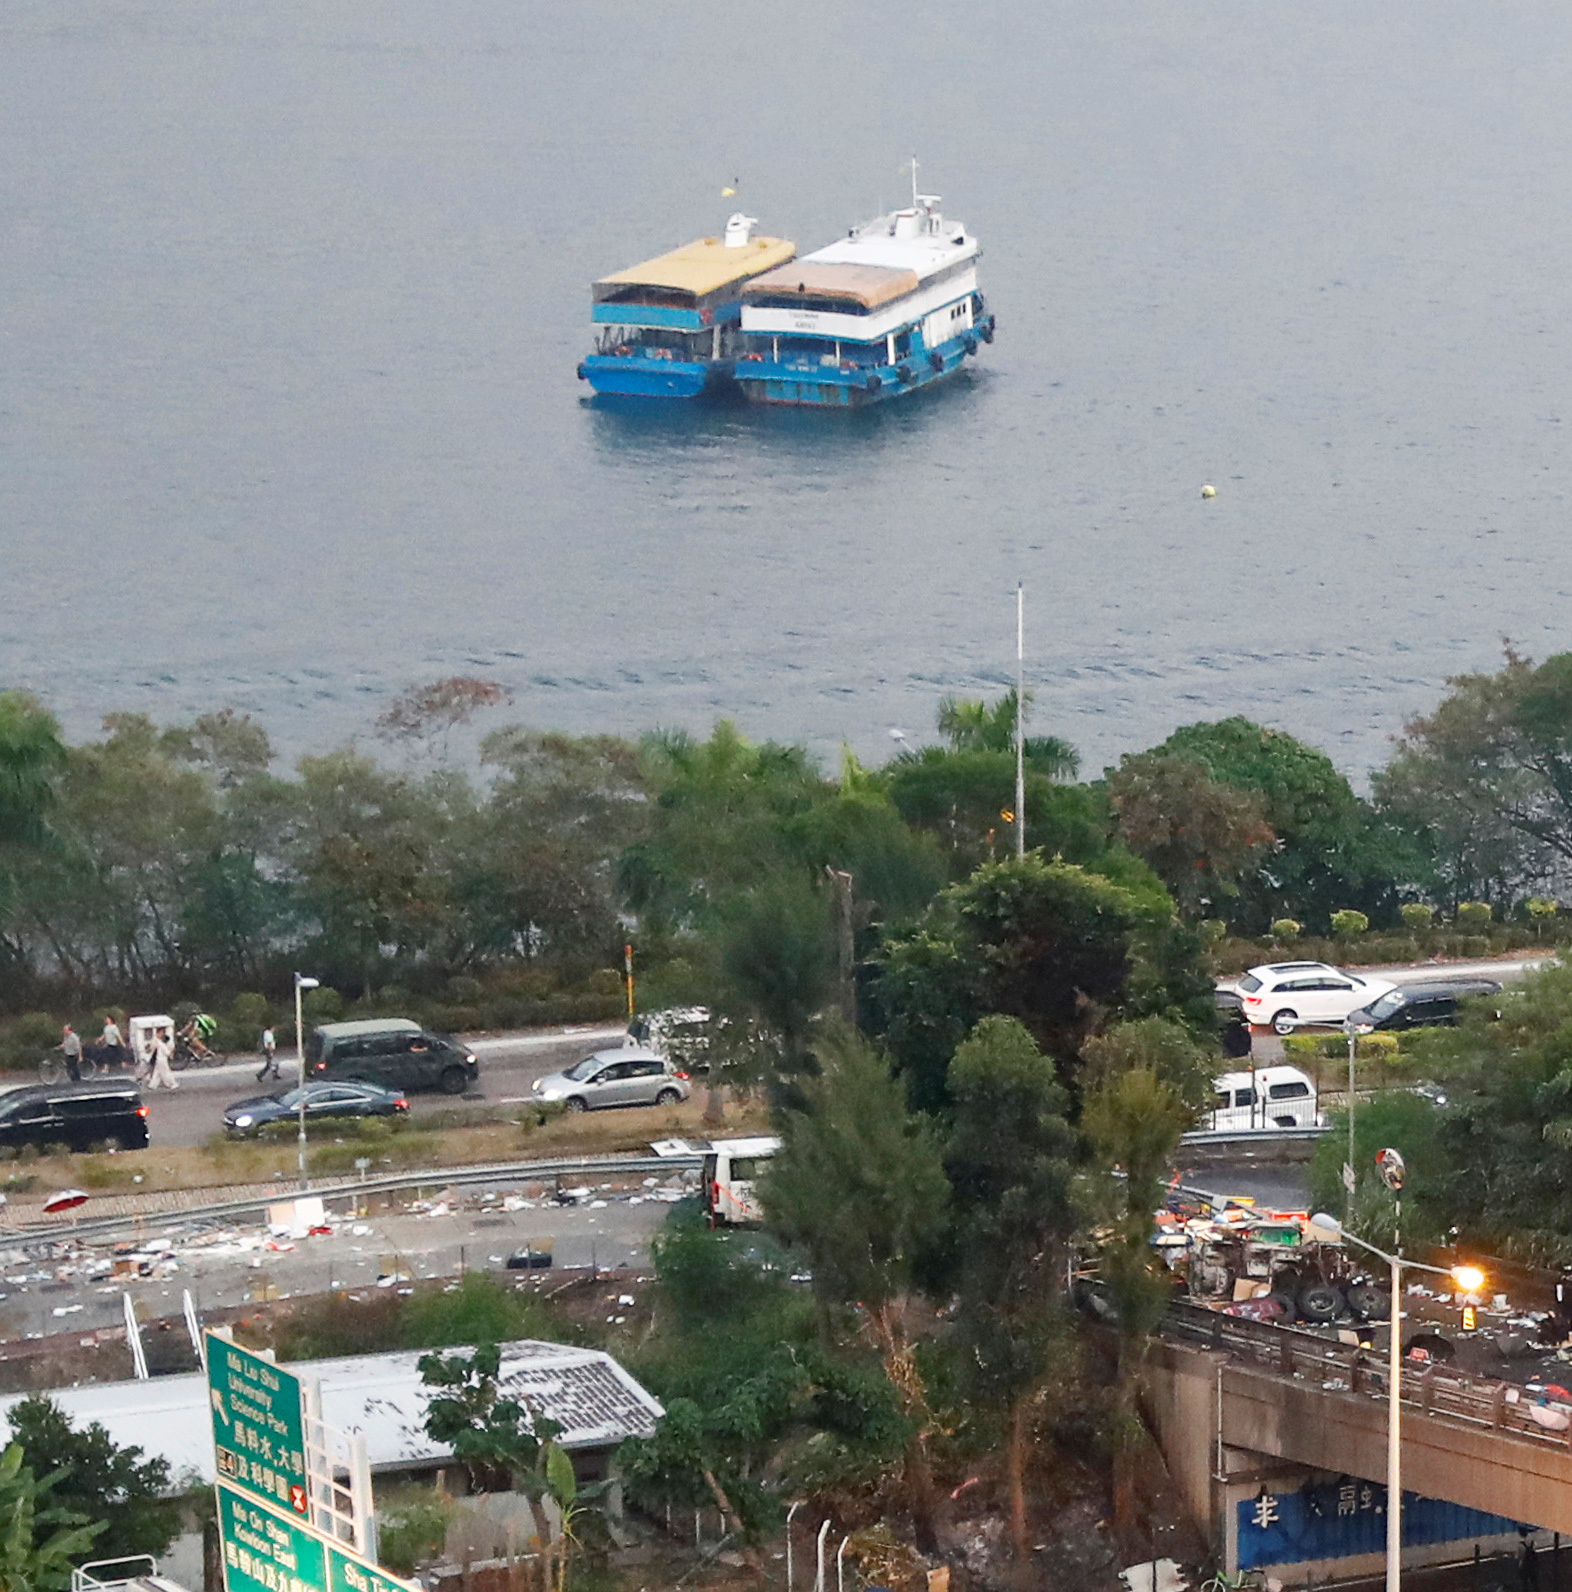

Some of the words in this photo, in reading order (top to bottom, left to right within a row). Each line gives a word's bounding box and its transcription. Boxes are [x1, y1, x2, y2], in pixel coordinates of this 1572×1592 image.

[227, 1352, 242, 1372] Ma
[227, 1372, 273, 1411] University
[230, 1393, 266, 1426] Science
[267, 1412, 288, 1437] Park
[232, 1501, 248, 1522] Ma
[249, 1511, 264, 1532] On
[265, 1519, 290, 1547] Shan
[233, 1521, 272, 1556] Kowloon
[273, 1543, 297, 1571] East
